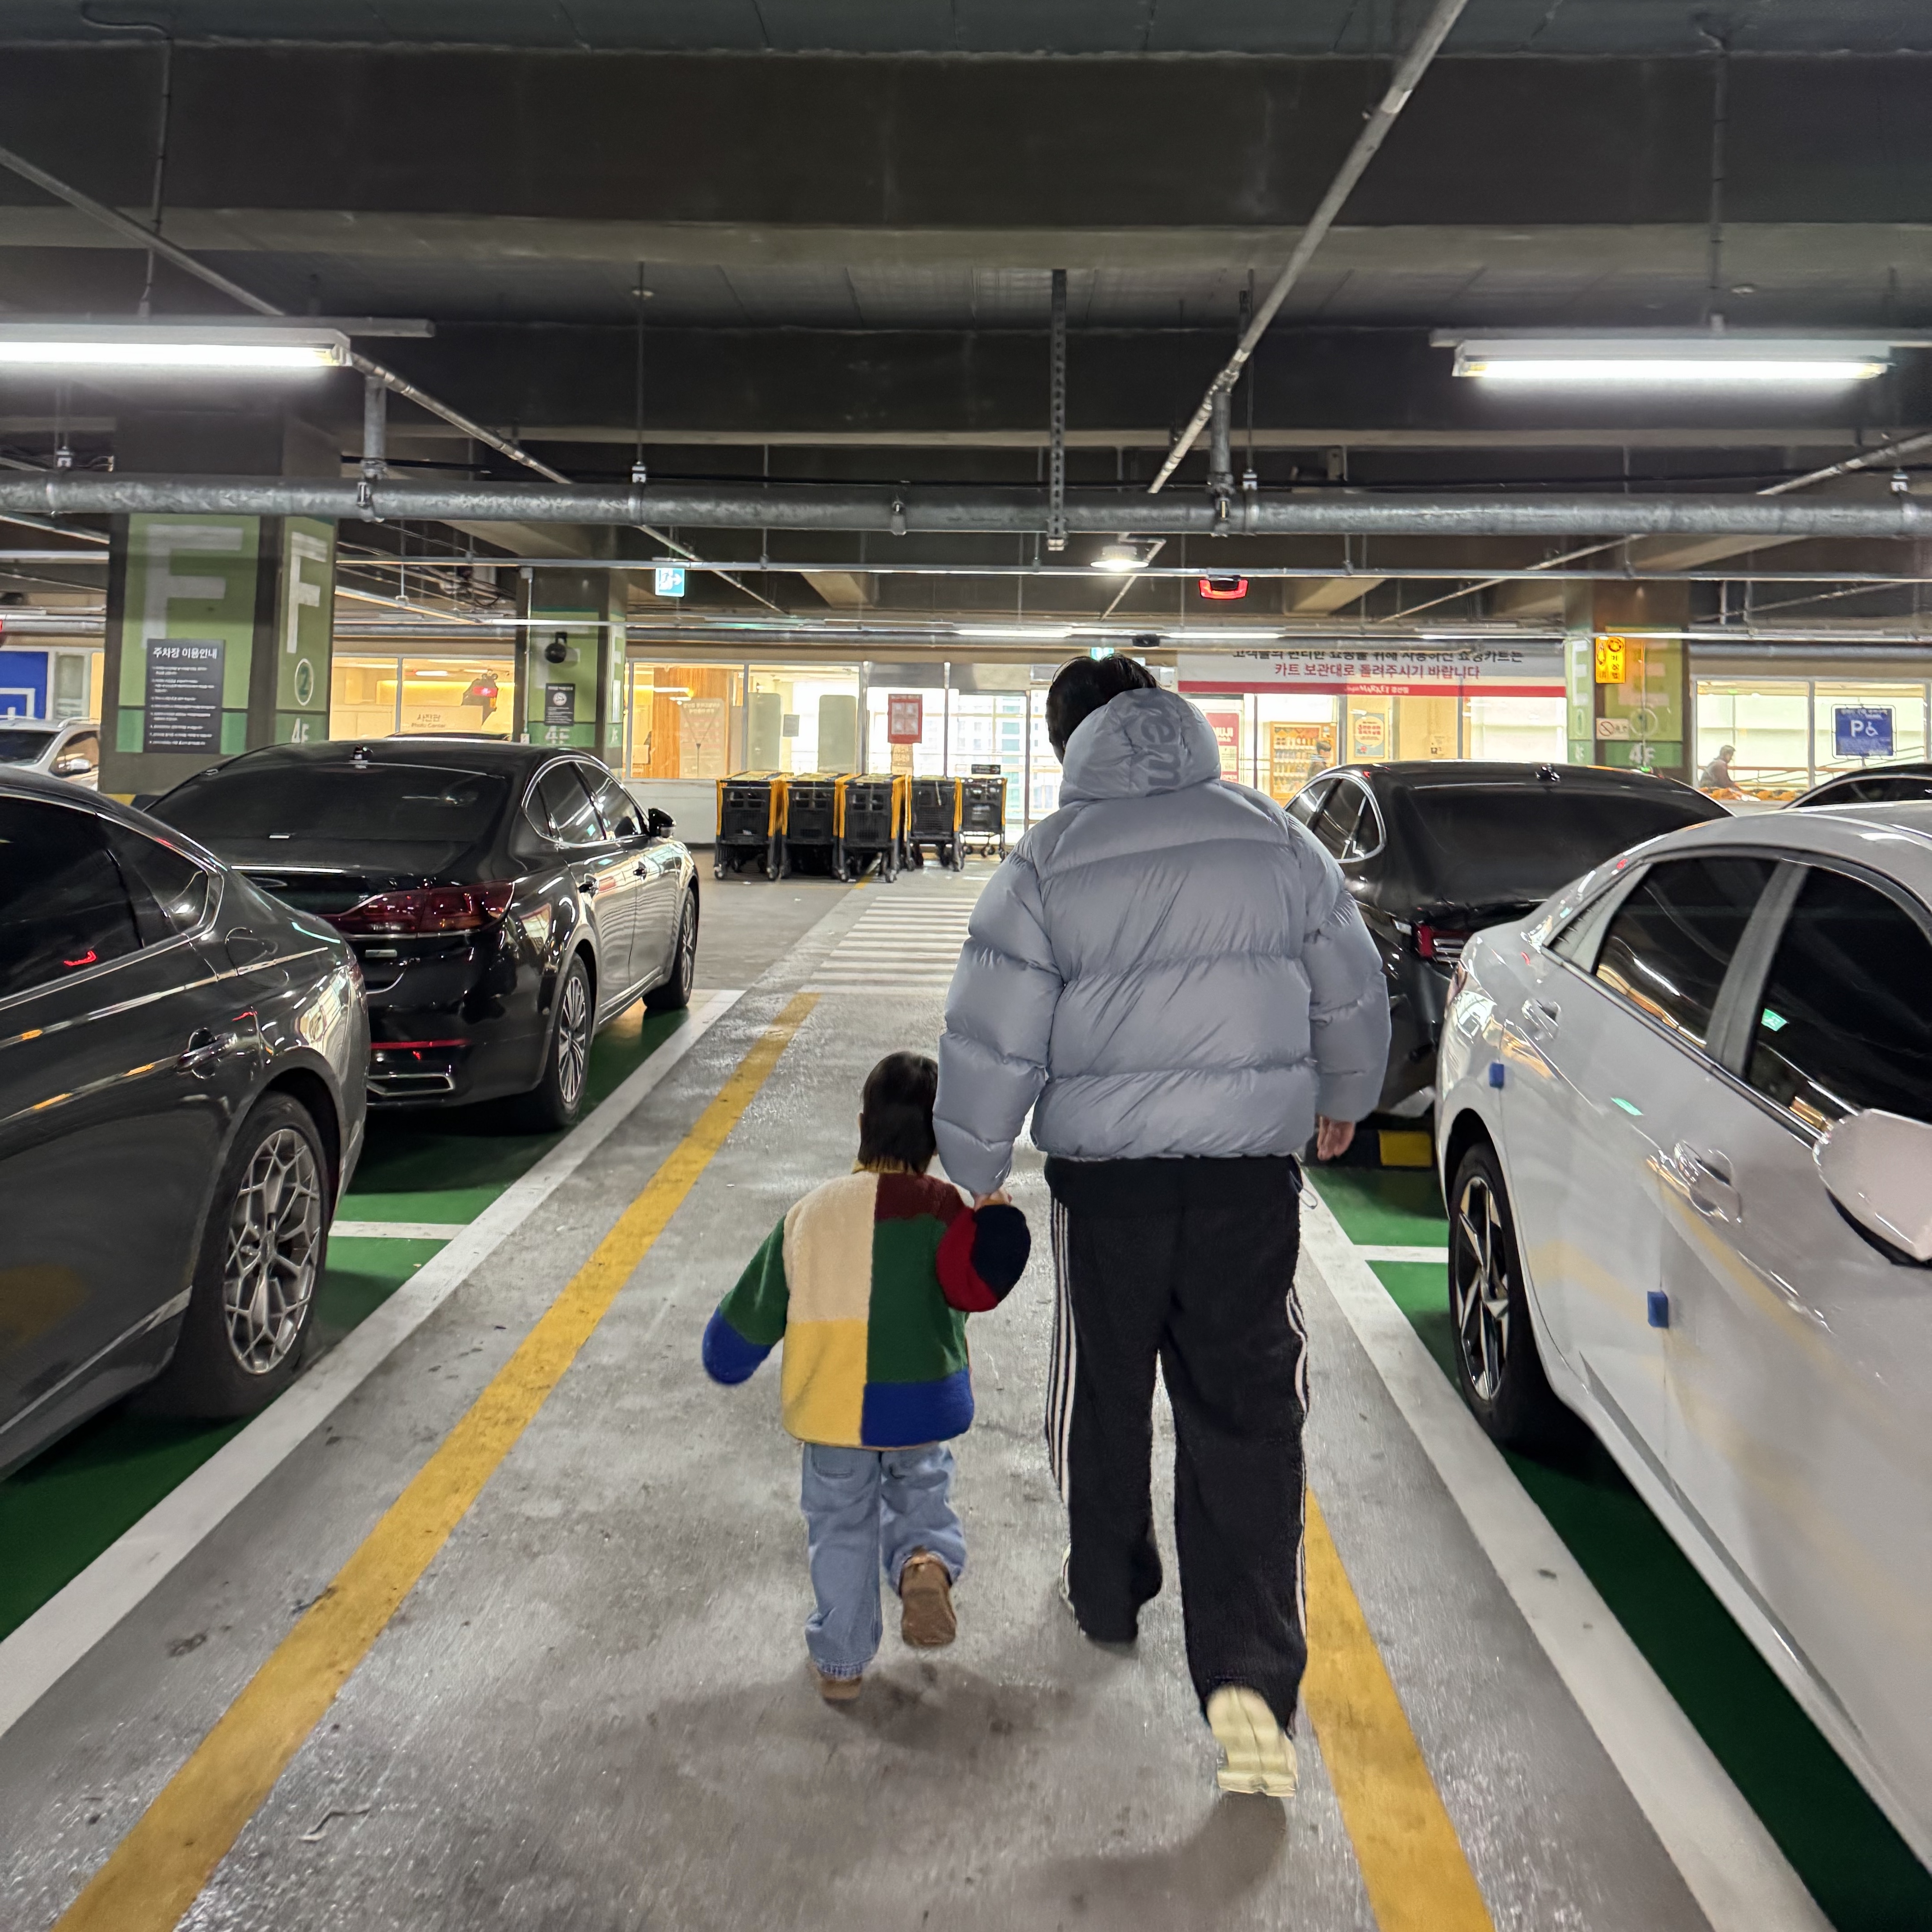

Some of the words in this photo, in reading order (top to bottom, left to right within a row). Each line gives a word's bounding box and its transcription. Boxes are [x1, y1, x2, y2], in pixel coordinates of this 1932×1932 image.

[142, 524, 244, 649] F
[287, 531, 328, 653] F
[153, 647, 180, 658] 주차장
[181, 648, 217, 659] 이용안내
[298, 666, 309, 695] 2
[1275, 662, 1300, 676] 카트
[1304, 663, 1355, 677] 보관대로
[1360, 663, 1423, 678] 돌려주시기
[1428, 665, 1480, 679] 바랍니다
[1572, 640, 1589, 706] E
[1851, 720, 1864, 737] P
